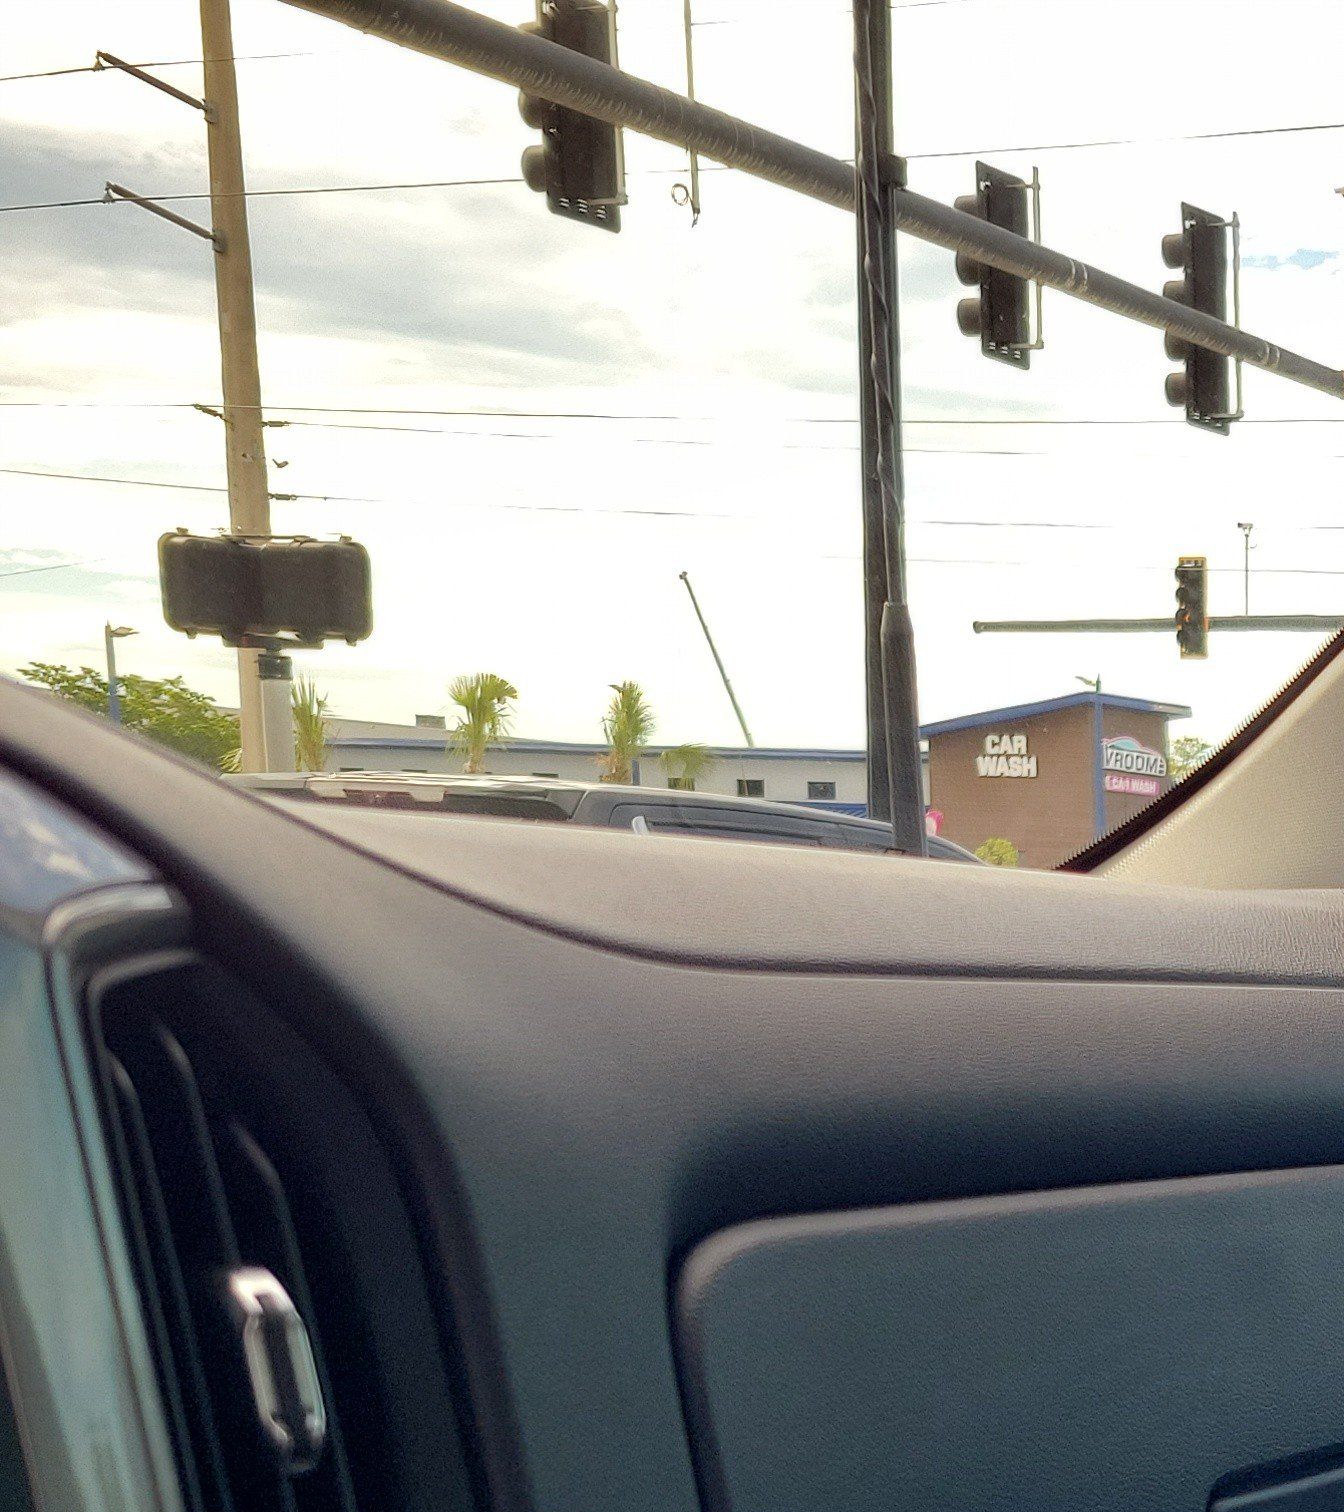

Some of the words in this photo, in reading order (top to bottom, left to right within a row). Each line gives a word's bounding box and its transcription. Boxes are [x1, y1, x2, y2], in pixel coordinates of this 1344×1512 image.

[985, 734, 1028, 755] CAR
[976, 754, 1037, 778] WASH
[1104, 744, 1159, 774] VROOM
